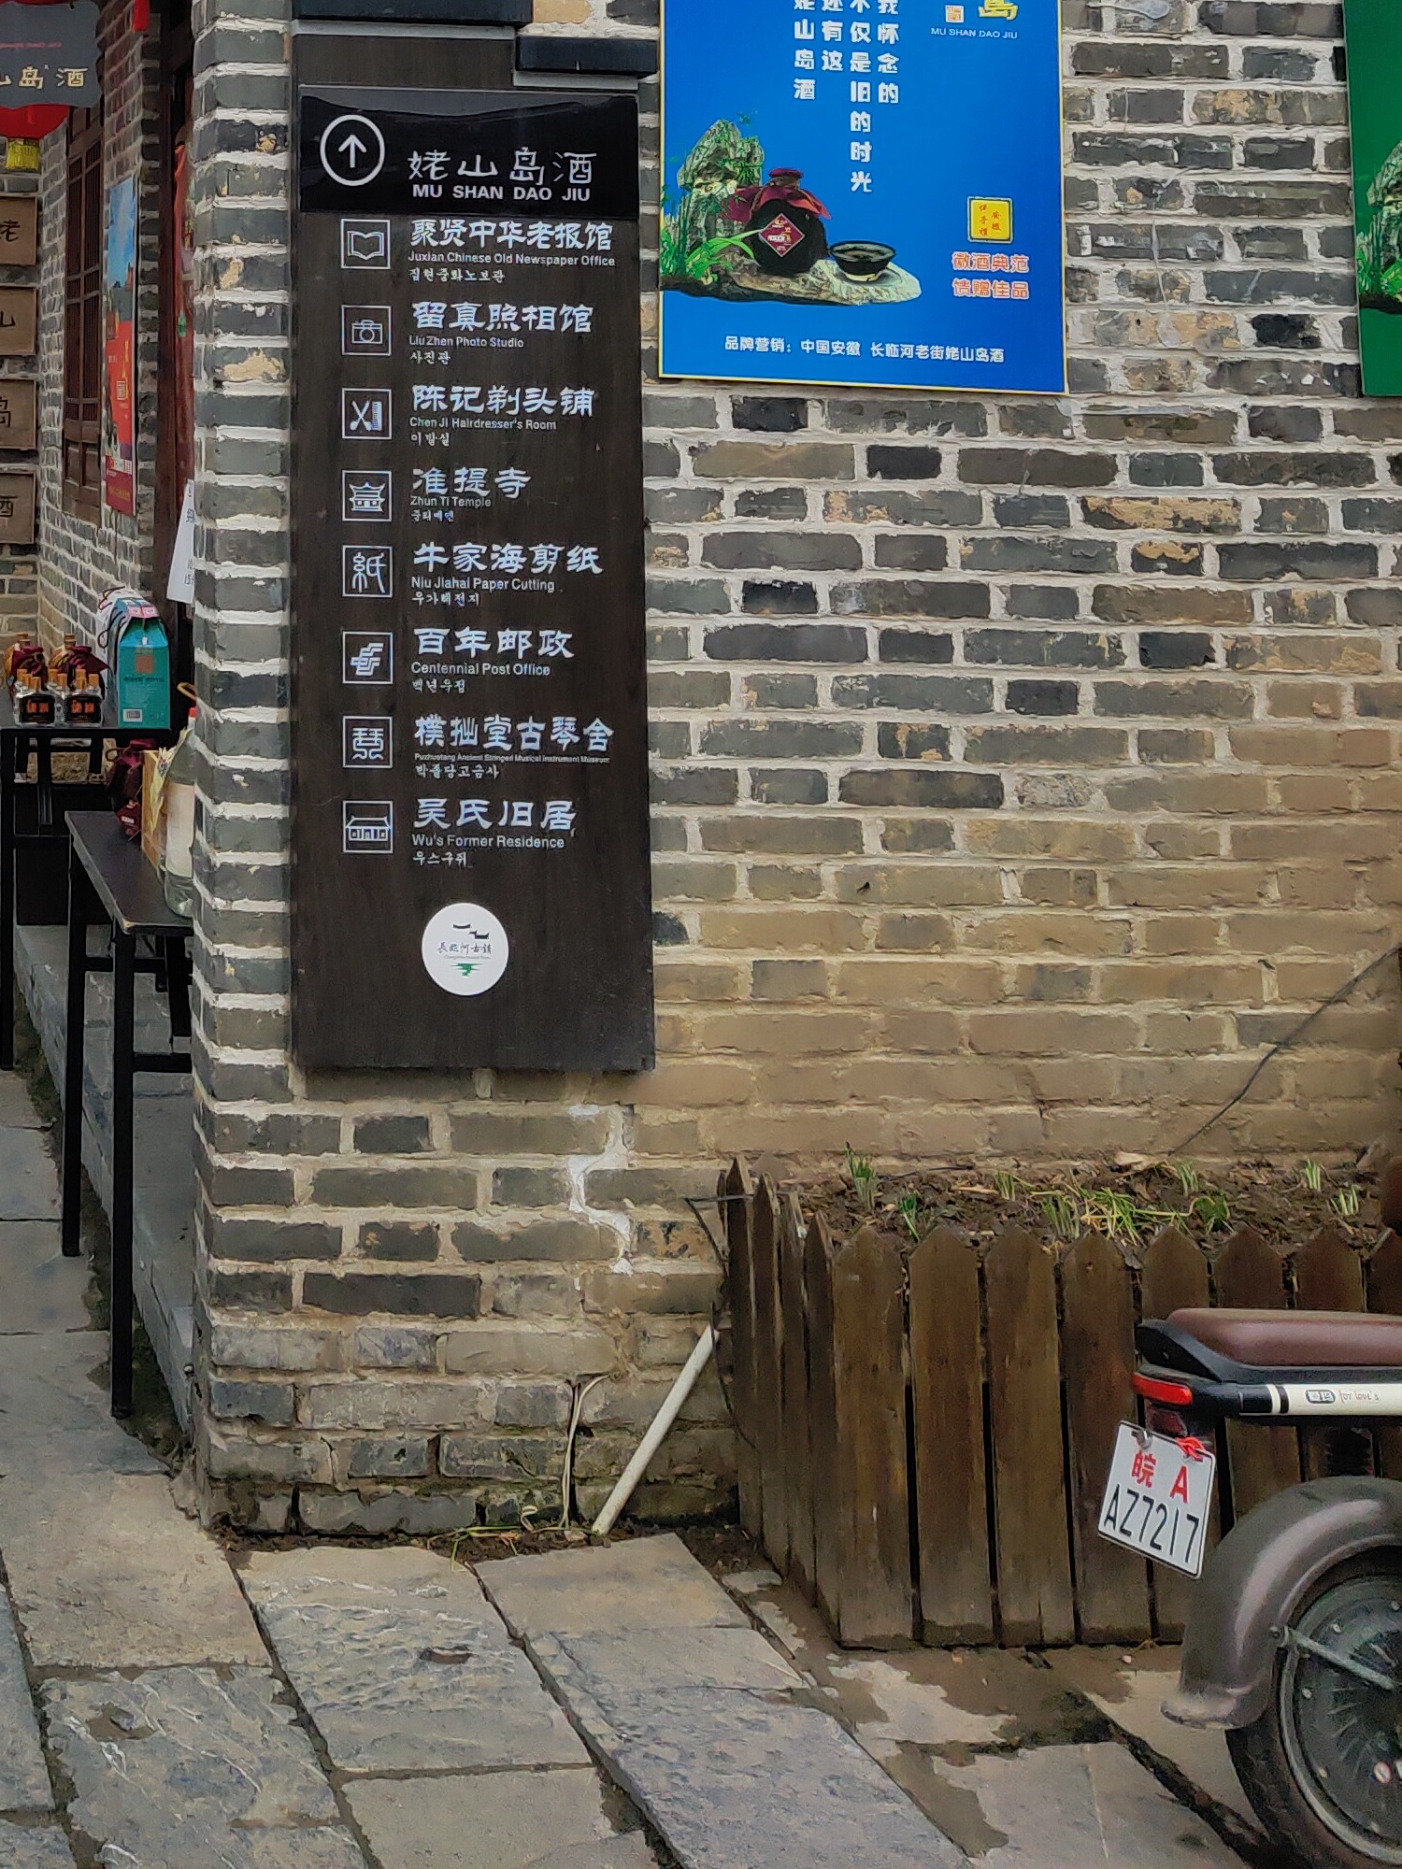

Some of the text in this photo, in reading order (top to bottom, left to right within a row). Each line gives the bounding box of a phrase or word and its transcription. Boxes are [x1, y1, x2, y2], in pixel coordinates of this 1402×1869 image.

[930, 27, 1018, 39] MU SHAN DAO JIU
[408, 147, 597, 185] 姥山岛酒
[412, 184, 590, 202] MU SHAN DAO JIU
[410, 219, 613, 250] 聚贤中华老报馆
[408, 250, 615, 267] Juxian Chinese Old Newspaper Office
[952, 251, 1029, 273] 徽酒典范
[952, 278, 1029, 300] 馈赠佳品
[411, 301, 594, 333] 留真照相馆
[456, 336, 487, 348] Photo
[489, 337, 524, 348] Studio
[801, 339, 861, 357] 中国安徽
[870, 342, 1005, 363] 长临河老街姥山岛酒
[412, 384, 595, 418] 陈记剃头铺
[452, 417, 523, 430] Hairdresser's
[525, 419, 556, 431] Room
[412, 466, 531, 499] 准提寺
[410, 495, 438, 507] Zhun
[451, 496, 492, 509] Temple
[413, 541, 604, 574] 牛家海剪纸
[411, 577, 555, 593] Niu Jiahai Paper Cutting
[413, 626, 575, 659] 百年邮政
[411, 661, 550, 676] Centennial Post Office
[414, 798, 577, 831] 吴氏旧居
[412, 833, 565, 848] Wu's Former Residence
[1104, 1483, 1199, 1564] AZ7217
